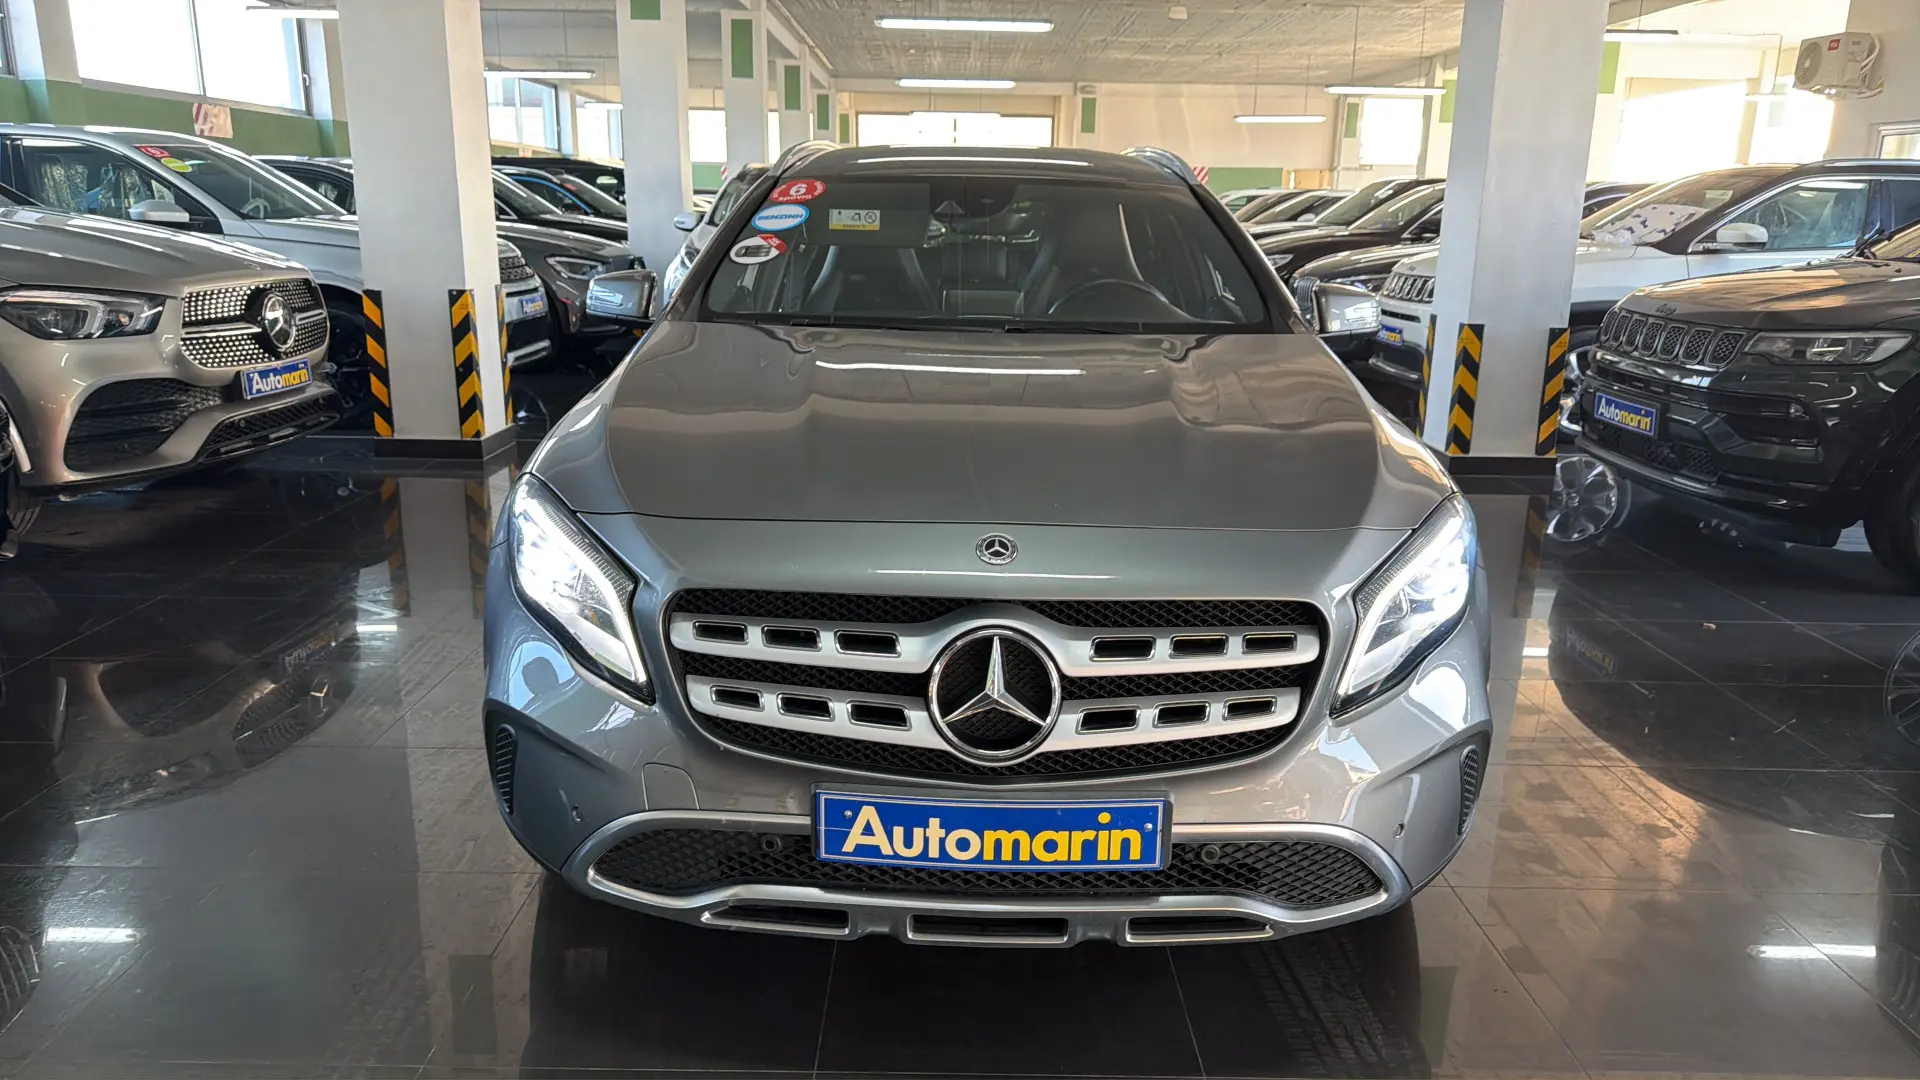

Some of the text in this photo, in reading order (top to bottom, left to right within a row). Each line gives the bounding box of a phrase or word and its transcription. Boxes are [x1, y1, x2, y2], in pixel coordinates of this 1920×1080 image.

[789, 183, 808, 196] 6
[252, 363, 309, 394] Automarin
[1597, 397, 1652, 431] Automarin
[841, 805, 1142, 862] Automarin
